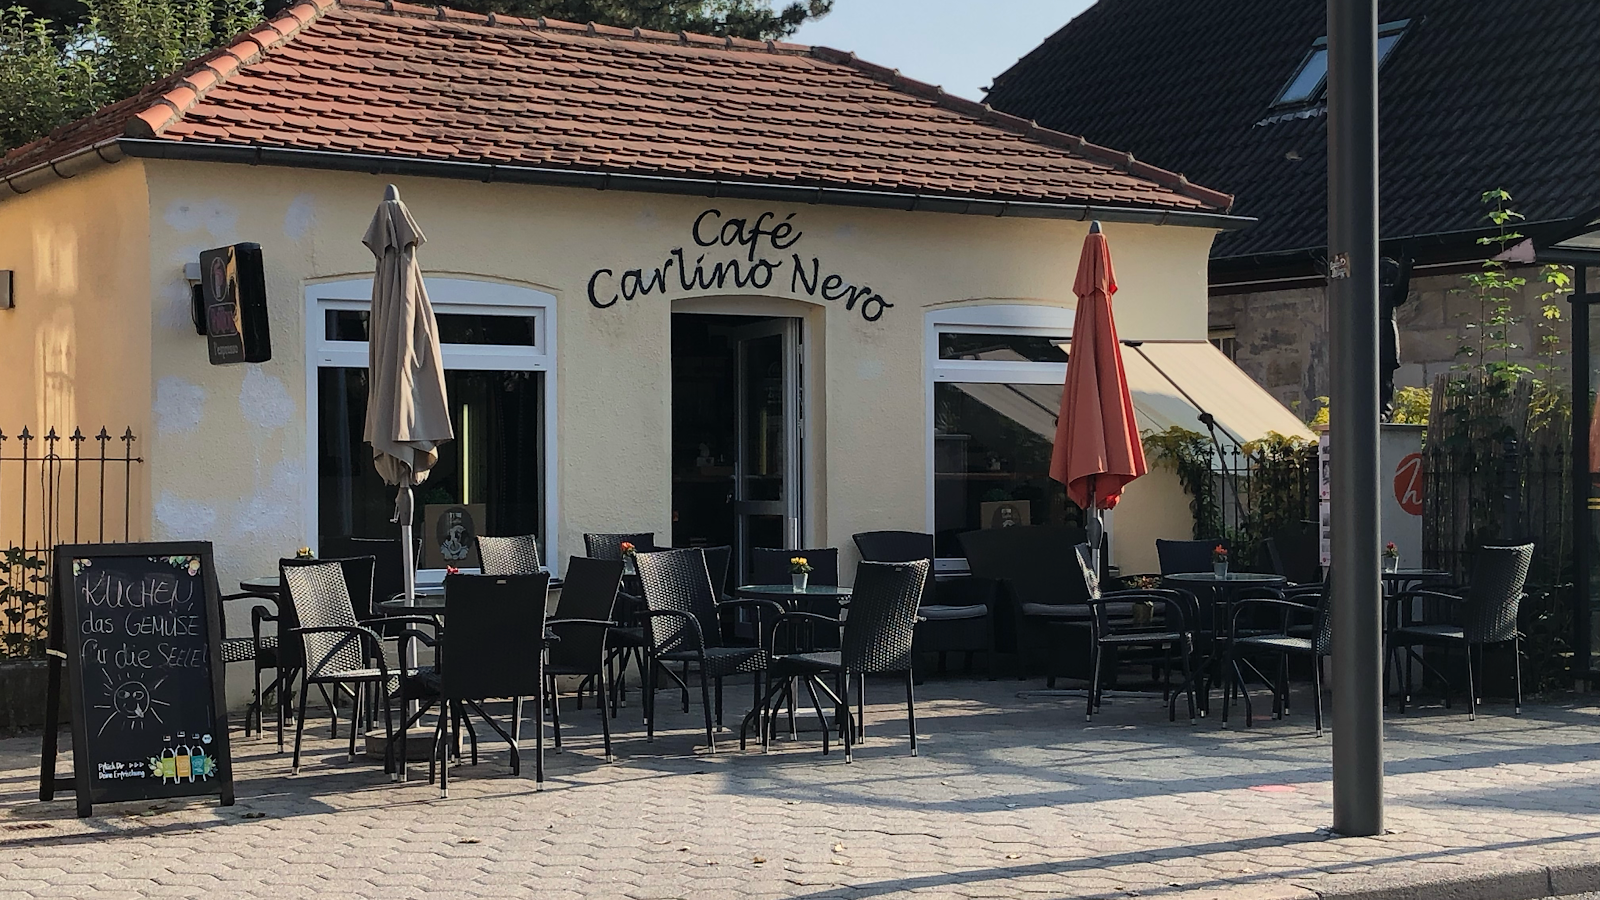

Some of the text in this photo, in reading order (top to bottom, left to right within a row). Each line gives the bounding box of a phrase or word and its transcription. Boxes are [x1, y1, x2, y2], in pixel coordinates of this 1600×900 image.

[692, 209, 803, 261] Café
[587, 247, 894, 322] Carlino Nero
[82, 609, 199, 636] das GEMÜSE
[115, 643, 153, 668] die
